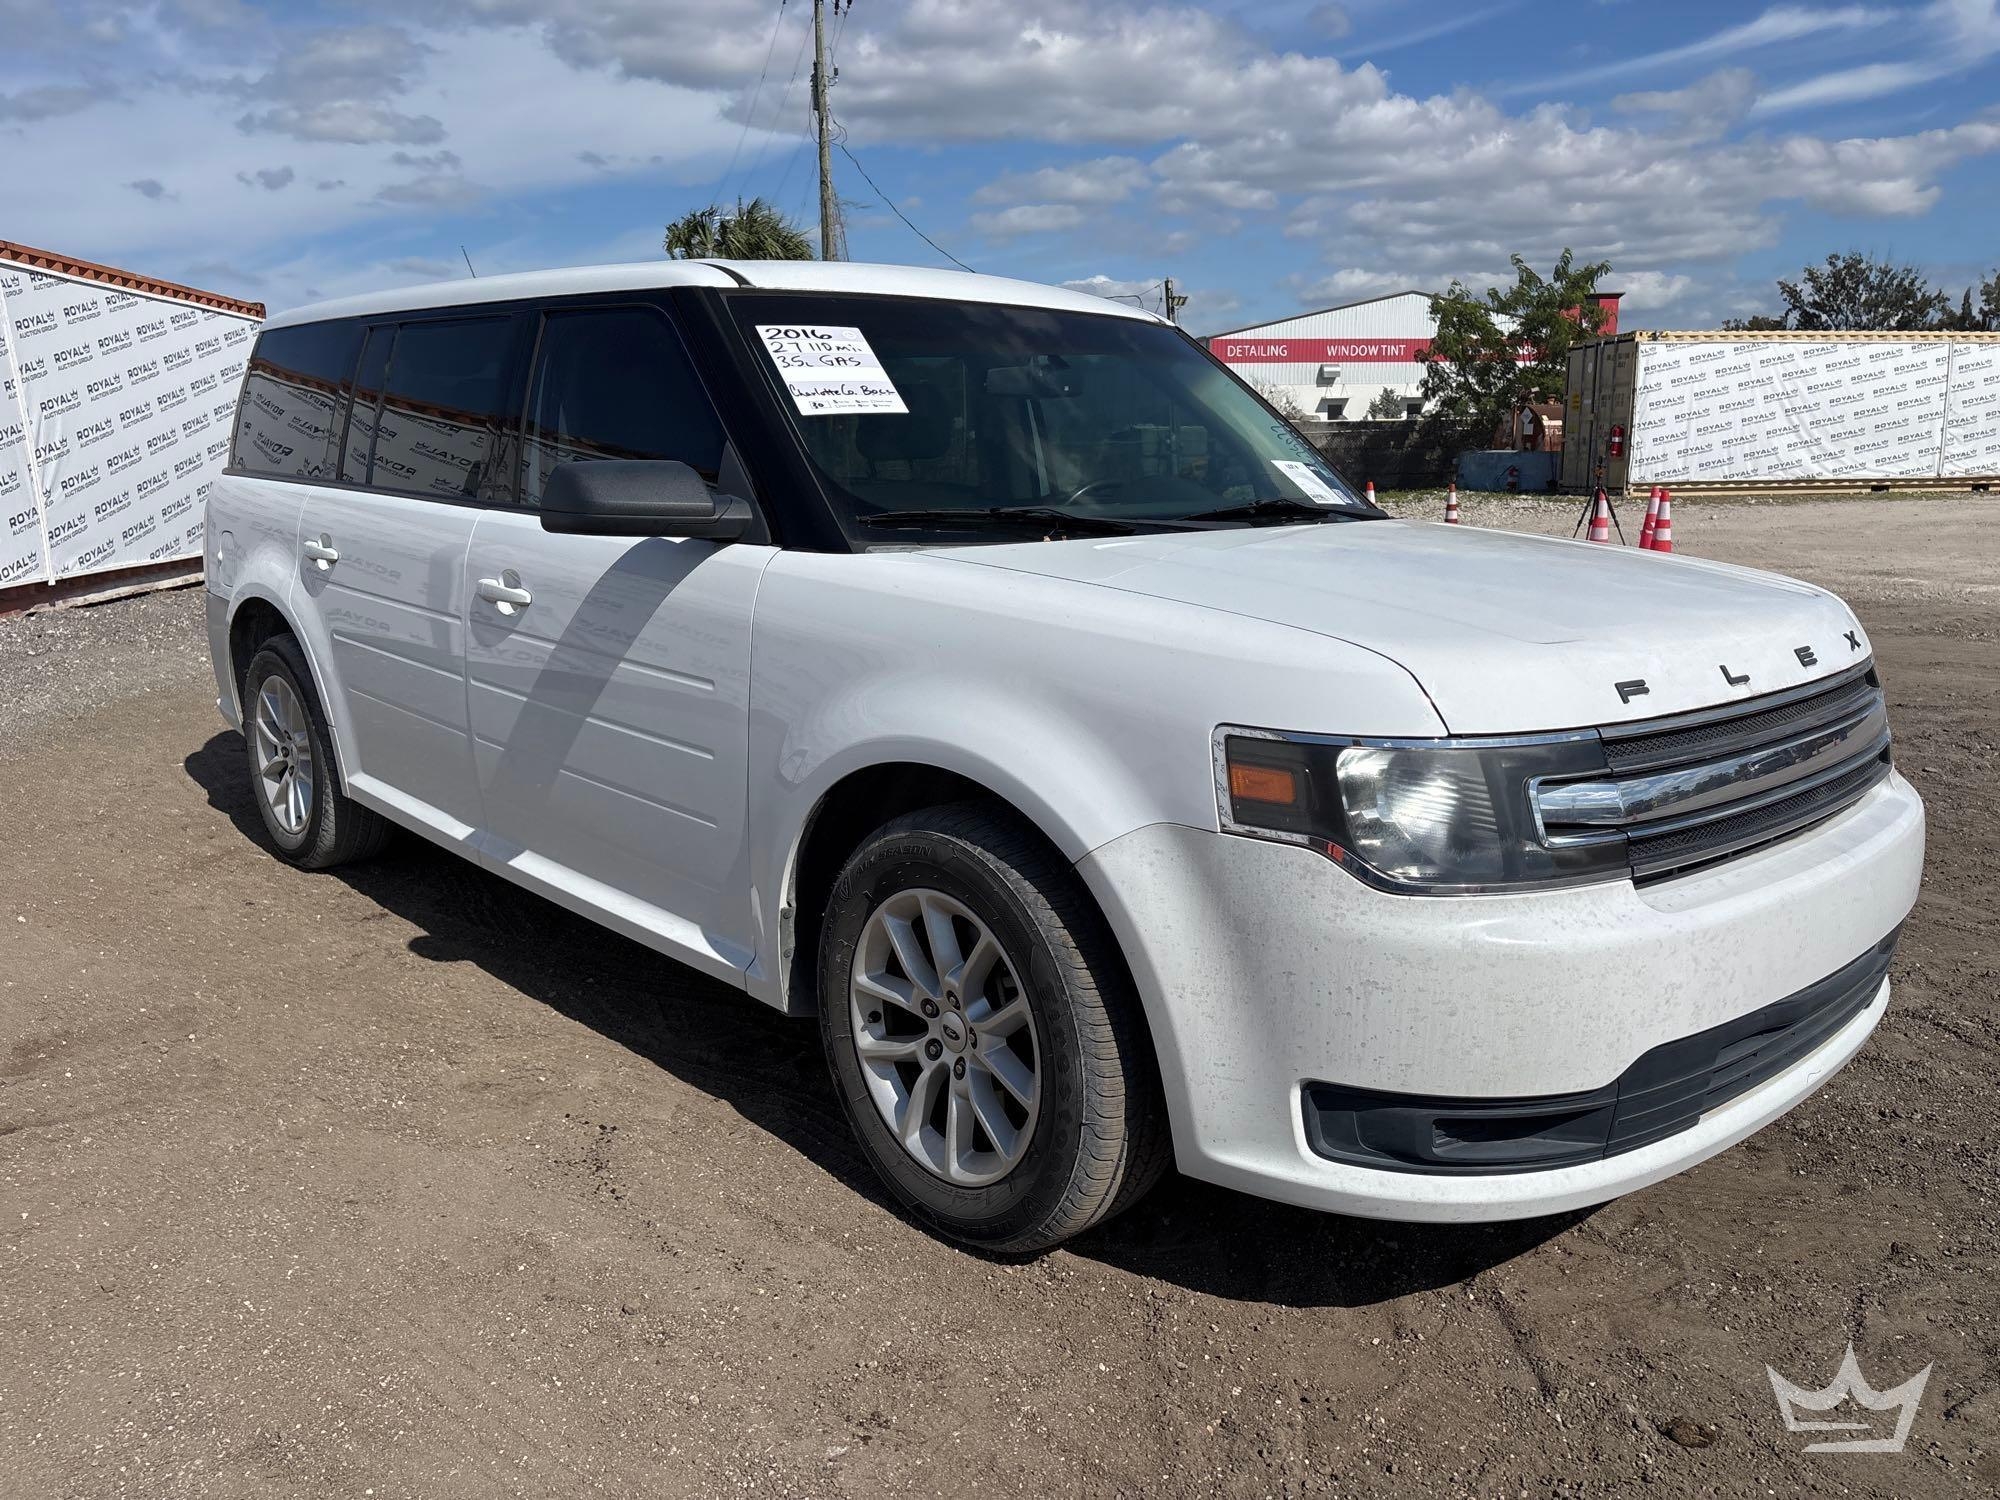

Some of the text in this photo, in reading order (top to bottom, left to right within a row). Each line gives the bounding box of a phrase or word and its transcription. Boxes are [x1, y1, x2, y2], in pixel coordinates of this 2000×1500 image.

[105, 292, 130, 306] ROYAL
[63, 302, 92, 317] ROYAL
[15, 314, 48, 330] ROYAL
[170, 311, 191, 325] ROYAL
[136, 322, 159, 336] ROYAL
[765, 328, 832, 340] 2016
[224, 330, 241, 341] ROYAL
[98, 334, 124, 348] ROYAL
[195, 340, 215, 353] ROYAL
[1227, 345, 1288, 357] DETAILING
[1327, 345, 1406, 356] WINDOW TINT
[1734, 343, 1761, 352] ROYAL
[1803, 346, 1830, 355] ROYAL
[54, 346, 84, 363] ROYAL
[164, 351, 185, 365] ROYAL
[1690, 352, 1717, 362] ROYAL
[1869, 350, 1896, 359] ROYAL
[819, 354, 861, 366] GAS
[1760, 355, 1787, 365] ROYAL
[1826, 360, 1853, 369] ROYAL
[19, 361, 37, 375] YAL
[128, 363, 152, 378] ROYAL
[1644, 362, 1672, 372] ROYAL
[1715, 365, 1743, 374] ROYAL
[1894, 363, 1920, 372] ROYAL
[1959, 361, 1985, 370] ROYAL
[220, 366, 238, 377] ROYAL
[1782, 369, 1809, 378] ROYAL
[1851, 372, 1878, 381] ROYAL
[1671, 374, 1698, 384] ROYAL
[1738, 378, 1766, 387] ROYAL
[1916, 376, 1940, 385] ROYAL
[87, 377, 114, 394] ROYAL
[191, 378, 211, 391] ROYAL
[1807, 382, 1834, 391] ROYAL
[1873, 385, 1900, 394] ROYAL
[1694, 388, 1721, 397] ROYAL
[1764, 391, 1791, 400] ROYAL
[40, 393, 72, 412] ROYAL
[157, 390, 180, 406] ROYAL
[1649, 398, 1677, 407] ROYAL
[1830, 394, 1856, 404] ROYAL
[1898, 398, 1922, 406] ROYAL
[1962, 396, 1989, 405] ROYAL
[214, 402, 232, 416] ROYAL
[1720, 400, 1747, 409] ROYAL
[1785, 404, 1812, 413] ROYAL
[120, 406, 145, 422] ROYAL
[1675, 410, 1702, 420] ROYAL
[1854, 407, 1881, 416] ROYAL
[1918, 410, 1944, 420] ROYAL
[1742, 413, 1769, 423] ROYAL
[1810, 417, 1837, 426] ROYAL
[1948, 416, 1970, 425] OYAL
[182, 416, 203, 432] ROYAL
[1697, 423, 1725, 433] ROYAL
[1875, 420, 1902, 429] ROYAL
[0, 424, 22, 440] OYAL
[77, 422, 105, 441] ROYAL
[1766, 426, 1792, 435] ROYAL
[1831, 429, 1858, 439] ROYAL
[1964, 430, 1990, 439] ROYAL
[147, 432, 171, 449] ROYAL
[1653, 433, 1680, 443] ROYAL
[1722, 436, 1749, 445] ROYAL
[207, 441, 227, 455] ROYAL
[1787, 439, 1815, 448] ROYAL
[1854, 441, 1881, 451] ROYAL
[35, 441, 61, 459] OYAL
[1677, 445, 1705, 455] ROYAL
[1744, 448, 1771, 458] ROYAL
[107, 449, 134, 468] ROYAL
[1811, 452, 1838, 460] ROYAL
[1875, 455, 1902, 463] ROYAL
[1945, 451, 1970, 460] ROYAL
[37, 457, 53, 467] CTION
[174, 456, 196, 473] ROYAL
[1699, 459, 1727, 468] ROYAL
[1768, 461, 1795, 470] ROYAL
[1655, 468, 1682, 477] ROYAL
[1832, 464, 1859, 473] ROYAL
[1899, 466, 1926, 475] ROYAL
[1965, 464, 1991, 474] ROYAL
[1723, 471, 1750, 479] ROYAL
[61, 470, 91, 491] ROYAL
[137, 474, 162, 493] ROYAL
[95, 495, 123, 516] ROYAL
[162, 498, 185, 517] ROYAL
[9, 507, 38, 528] ROYA
[48, 519, 78, 541] ROYAL
[122, 520, 148, 540] ROYAL
[187, 522, 203, 538] ROYA
[78, 544, 107, 567] ROYAL
[150, 541, 174, 560] ROYAL
[1614, 630, 1862, 704] FLEX
